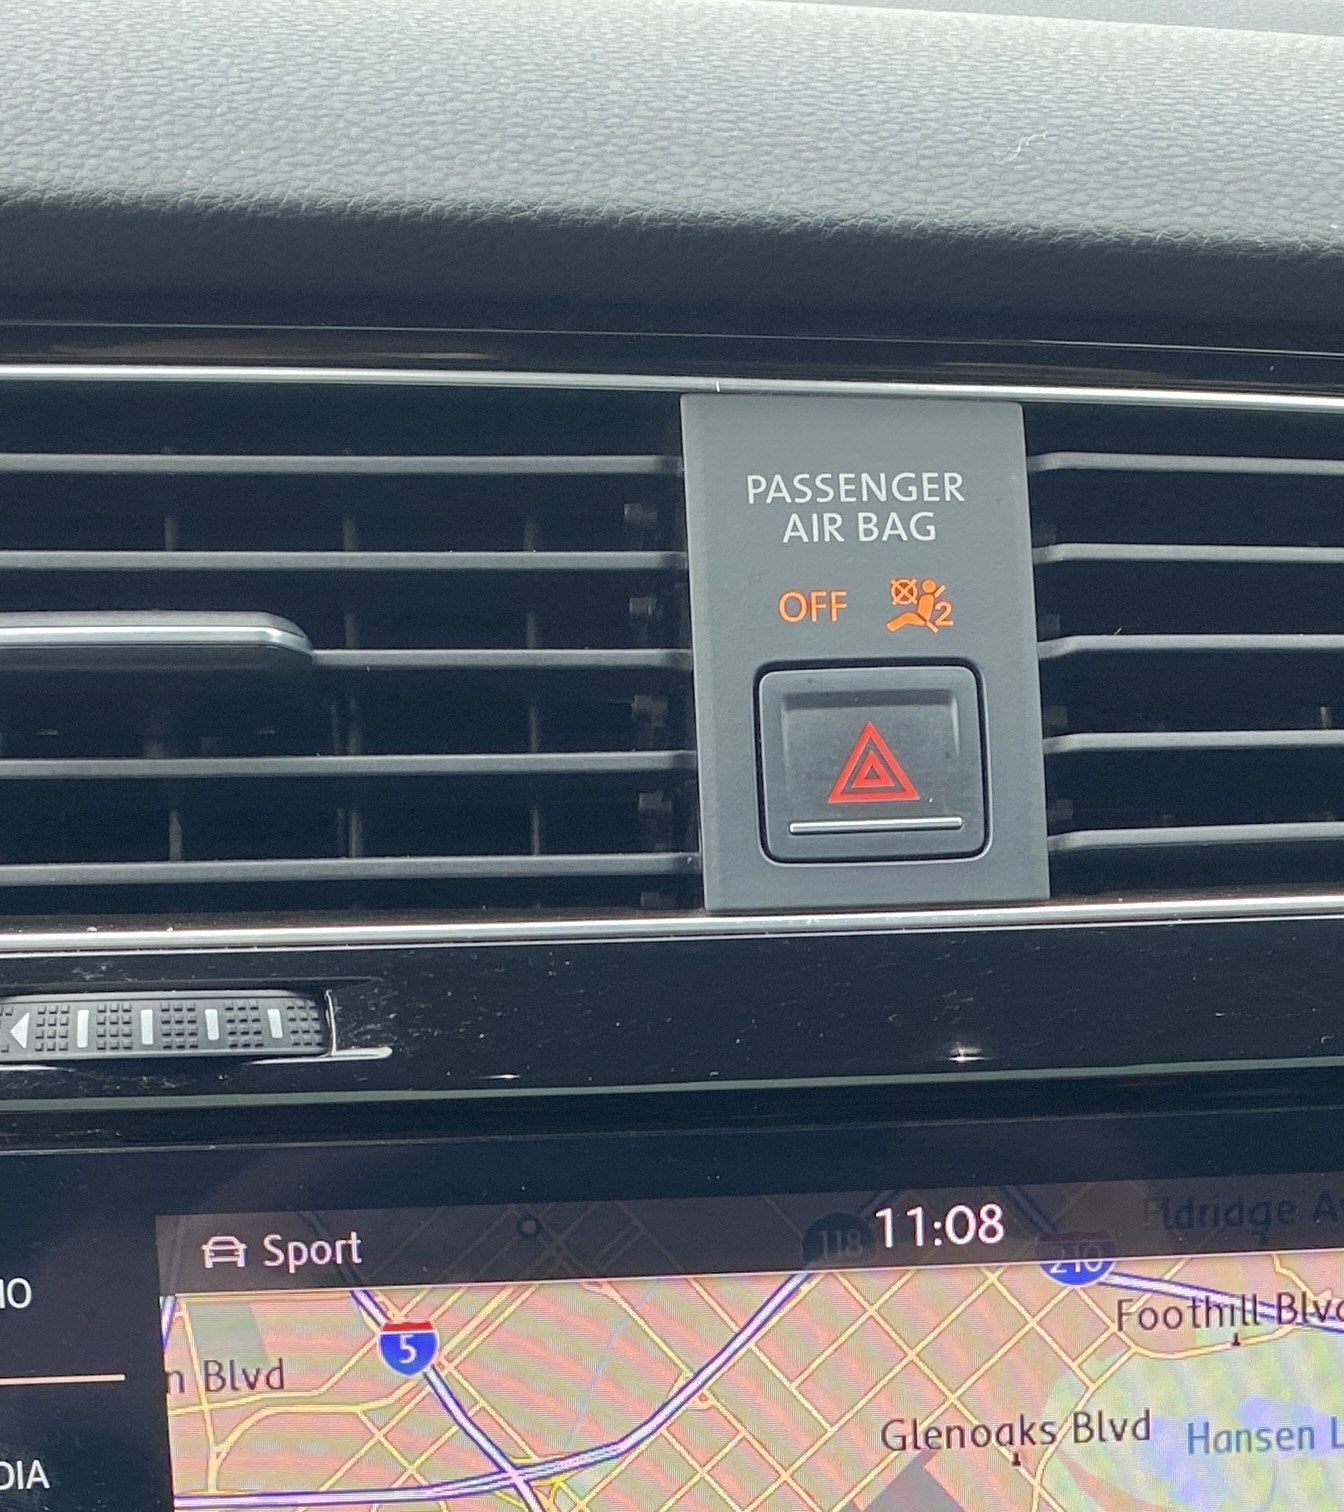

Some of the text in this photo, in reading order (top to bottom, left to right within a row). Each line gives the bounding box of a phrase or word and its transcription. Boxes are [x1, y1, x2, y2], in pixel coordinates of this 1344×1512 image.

[747, 472, 966, 504] PASSENGER
[782, 511, 937, 544] AIR BAG
[778, 589, 847, 624] OFF
[875, 1202, 1005, 1248] 11:08
[263, 1231, 362, 1274] Sport
[1116, 1294, 1259, 1332] Foothill
[398, 1335, 418, 1364] 5
[204, 1357, 285, 1393] Blvd
[881, 1409, 1152, 1452] Glenoaks Blvd
[1187, 1420, 1316, 1455] Hansen
